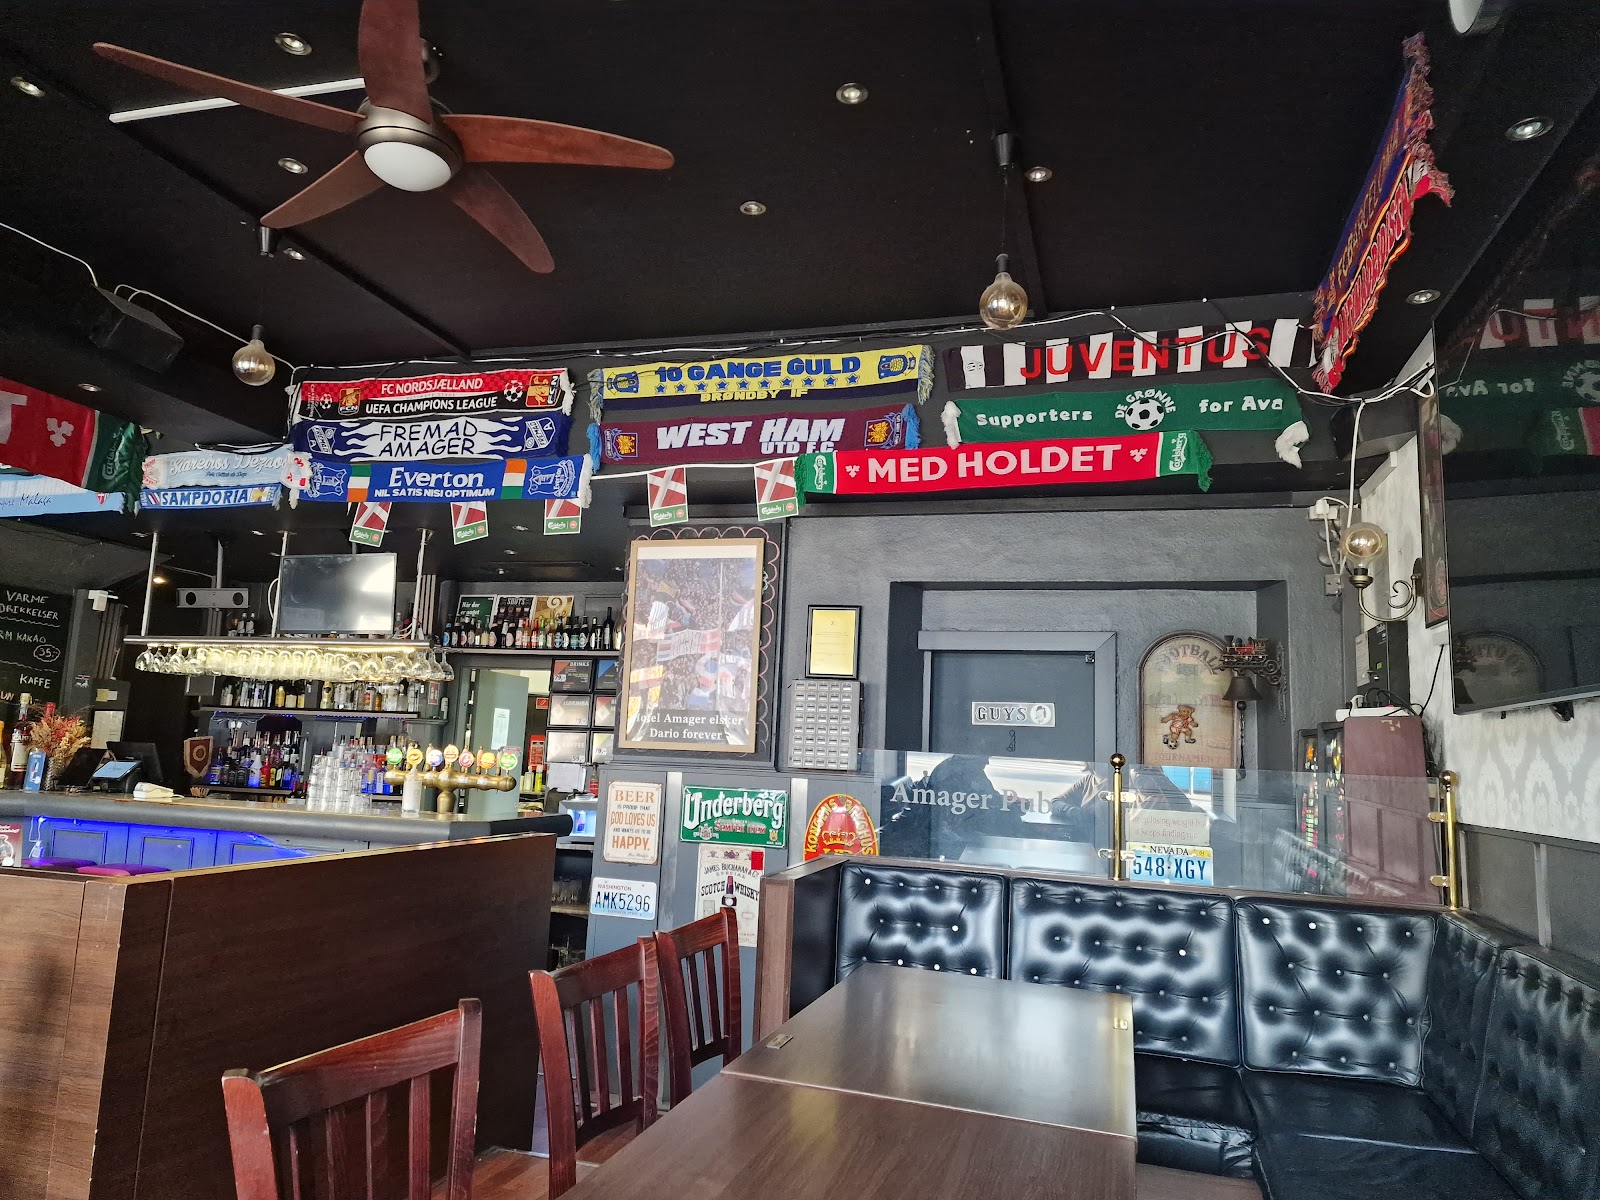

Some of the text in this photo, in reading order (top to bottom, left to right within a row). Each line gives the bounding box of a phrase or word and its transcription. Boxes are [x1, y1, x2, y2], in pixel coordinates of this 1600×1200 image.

[1020, 326, 1271, 379] JUVENTUS
[656, 356, 860, 382] 10 GANGE GULD
[381, 378, 483, 394] FC NORDSJÆLLAND
[790, 388, 808, 397] IF
[365, 396, 498, 414] UEFA CHAMPIONS LEAGUE
[1115, 389, 1176, 419] DE GRØNNE
[1199, 396, 1283, 413] for Ava
[976, 408, 1092, 428] Supporters
[380, 419, 478, 441] FREMAD
[657, 418, 846, 450] WEST HAM
[379, 438, 475, 457] AMAGER
[761, 441, 796, 454] UTD
[1169, 433, 1187, 471] Carlsberg
[813, 454, 827, 490] Carlsberg
[868, 444, 1122, 483] MED HOLDET
[388, 466, 485, 488] Everton
[162, 490, 249, 506] SAMPDORIA
[374, 488, 495, 498] NIL SATIS NISI OPTIMUM
[6, 590, 49, 604] VARME
[0, 603, 58, 620] DRIKKELSER
[17, 632, 46, 643] KAKAO
[20, 674, 51, 689] KAFFE
[664, 713, 706, 726] Amager
[709, 714, 744, 726] elsker
[976, 706, 1027, 721] GUYS
[650, 728, 722, 739] Dario forever
[615, 790, 655, 803] BEER
[890, 782, 1052, 815] Amager Pub
[683, 790, 784, 830] Underberg
[611, 811, 655, 827] GOD LOVES US
[804, 799, 838, 853] KONGENS
[612, 835, 650, 851] HAPPY.
[1149, 845, 1189, 856] NEVADA
[704, 864, 720, 875] JAMES
[721, 863, 748, 874] BUCHANAN
[701, 881, 760, 901] SCOTCH WHISKY
[594, 891, 651, 912] AMK5296
